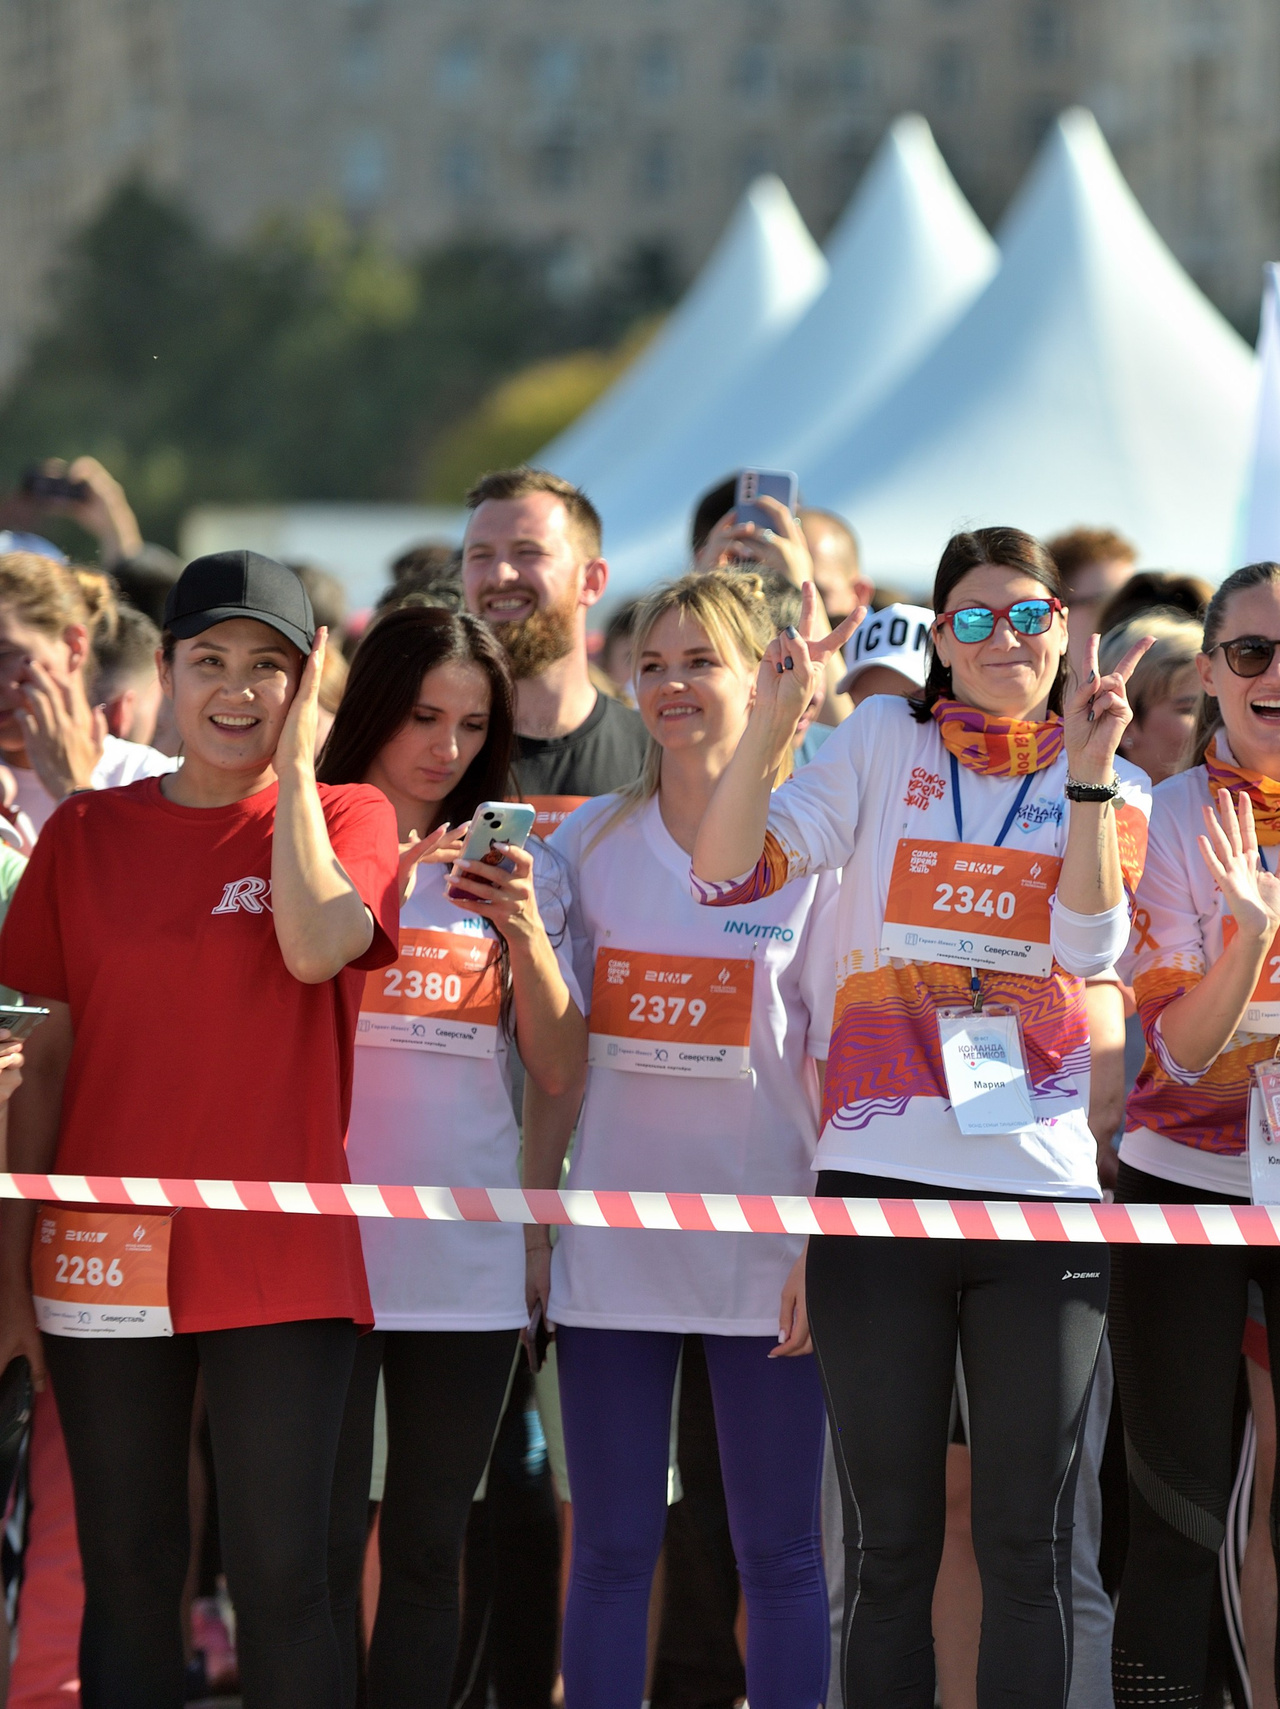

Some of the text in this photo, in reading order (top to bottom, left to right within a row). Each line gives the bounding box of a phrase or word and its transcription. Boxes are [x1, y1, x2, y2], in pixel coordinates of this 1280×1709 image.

[856, 618, 927, 660] ICON
[932, 883, 1016, 920] 2340
[723, 920, 794, 942] INVITRO
[984, 945, 1027, 958] Северсталь
[383, 968, 462, 1003] 2380
[629, 993, 707, 1027] 2379
[435, 1028, 474, 1040] Северсталь
[958, 1044, 1004, 1053] КОМАНДА
[679, 1052, 723, 1063] Северсталь
[963, 1051, 1006, 1060] МЕДИКОВ
[974, 1081, 1005, 1091] Мария
[55, 1253, 124, 1287] 2286
[101, 1313, 145, 1324] Северсталь
